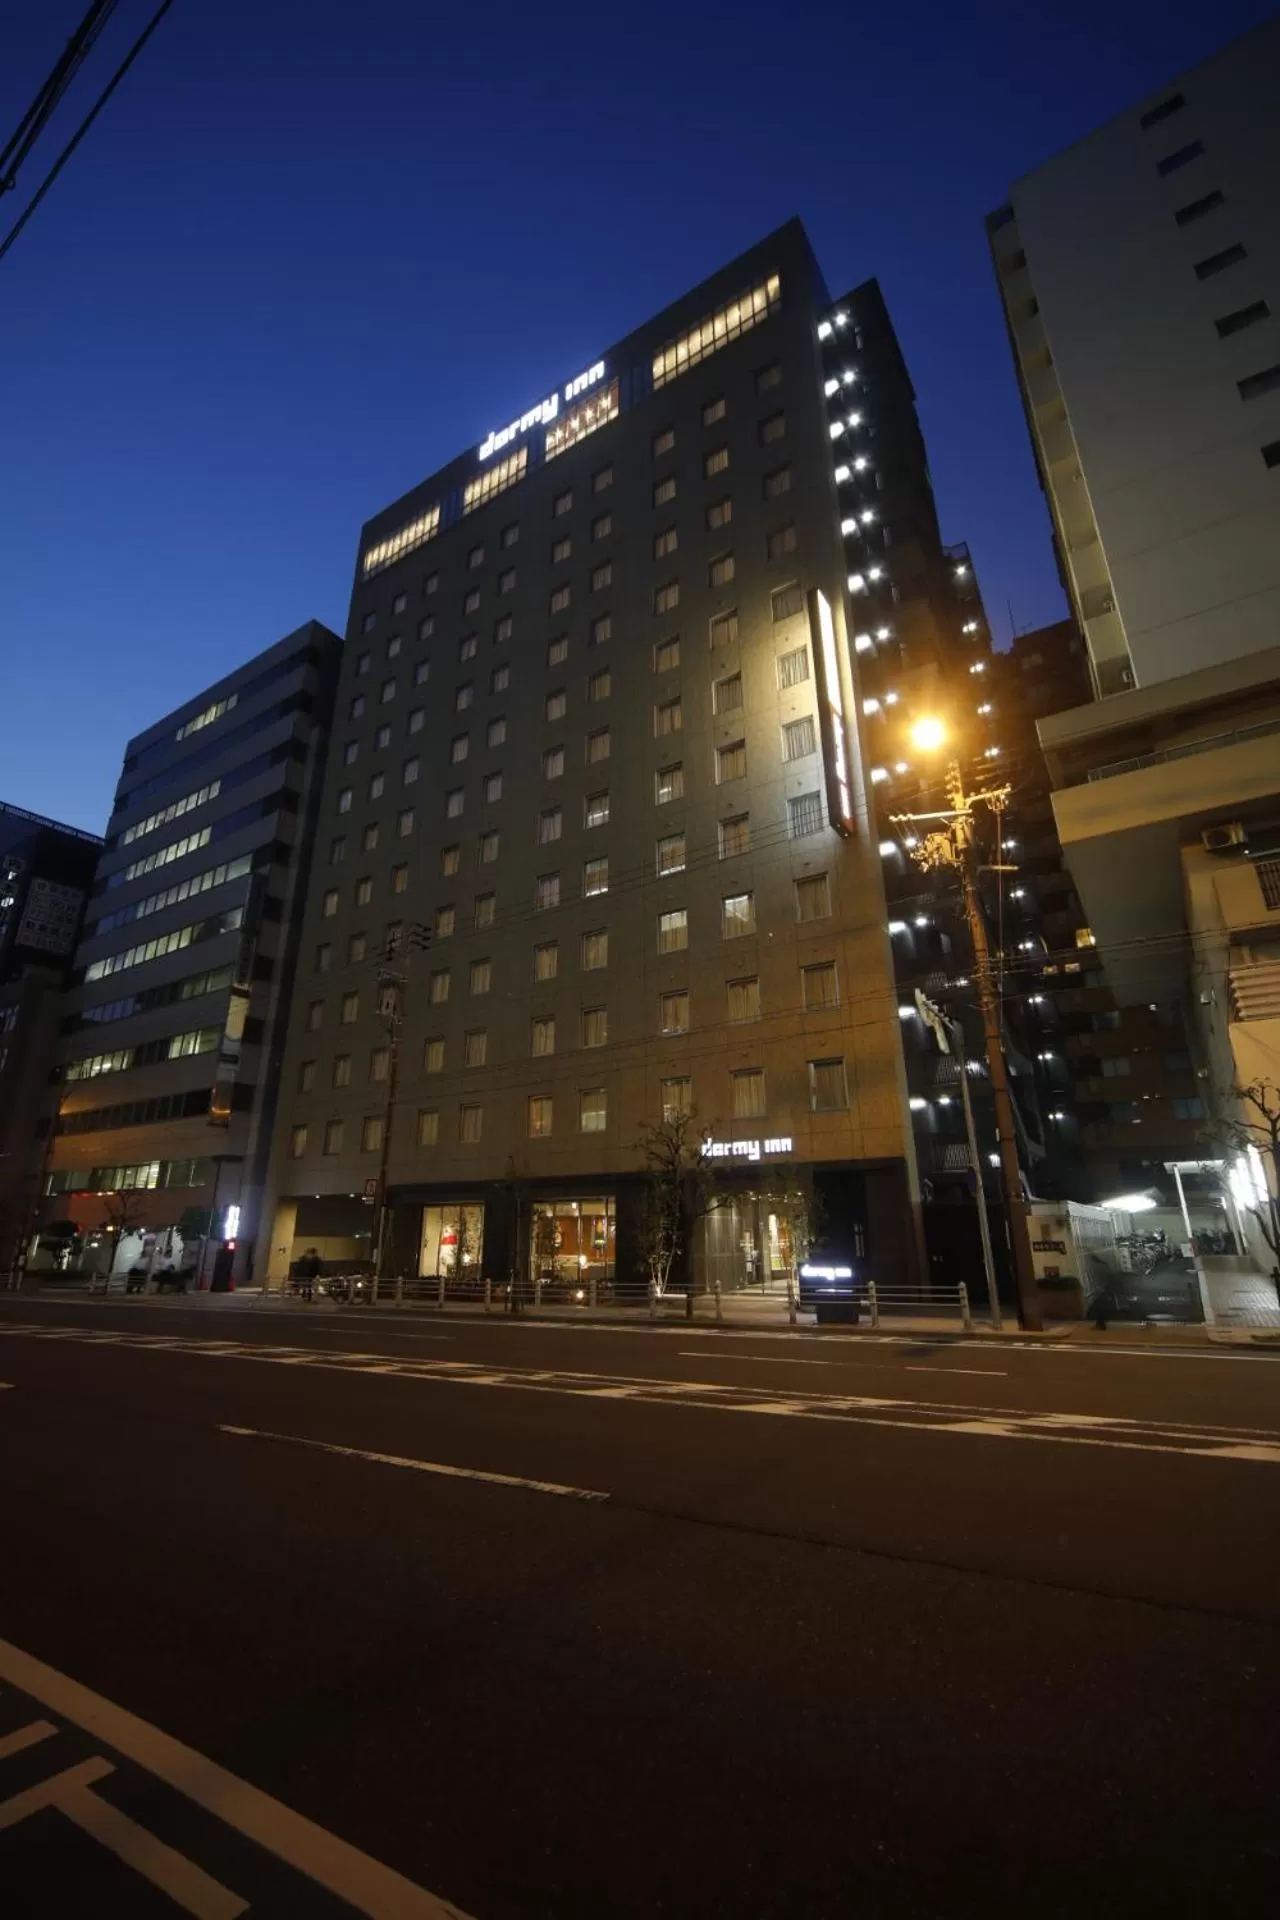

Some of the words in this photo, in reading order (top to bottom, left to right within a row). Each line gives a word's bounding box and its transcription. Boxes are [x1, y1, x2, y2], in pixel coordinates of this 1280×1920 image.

[479, 394, 559, 461] dormy
[565, 361, 605, 400] inn
[702, 1138, 760, 1161] dormy
[765, 1138, 792, 1153] inn
